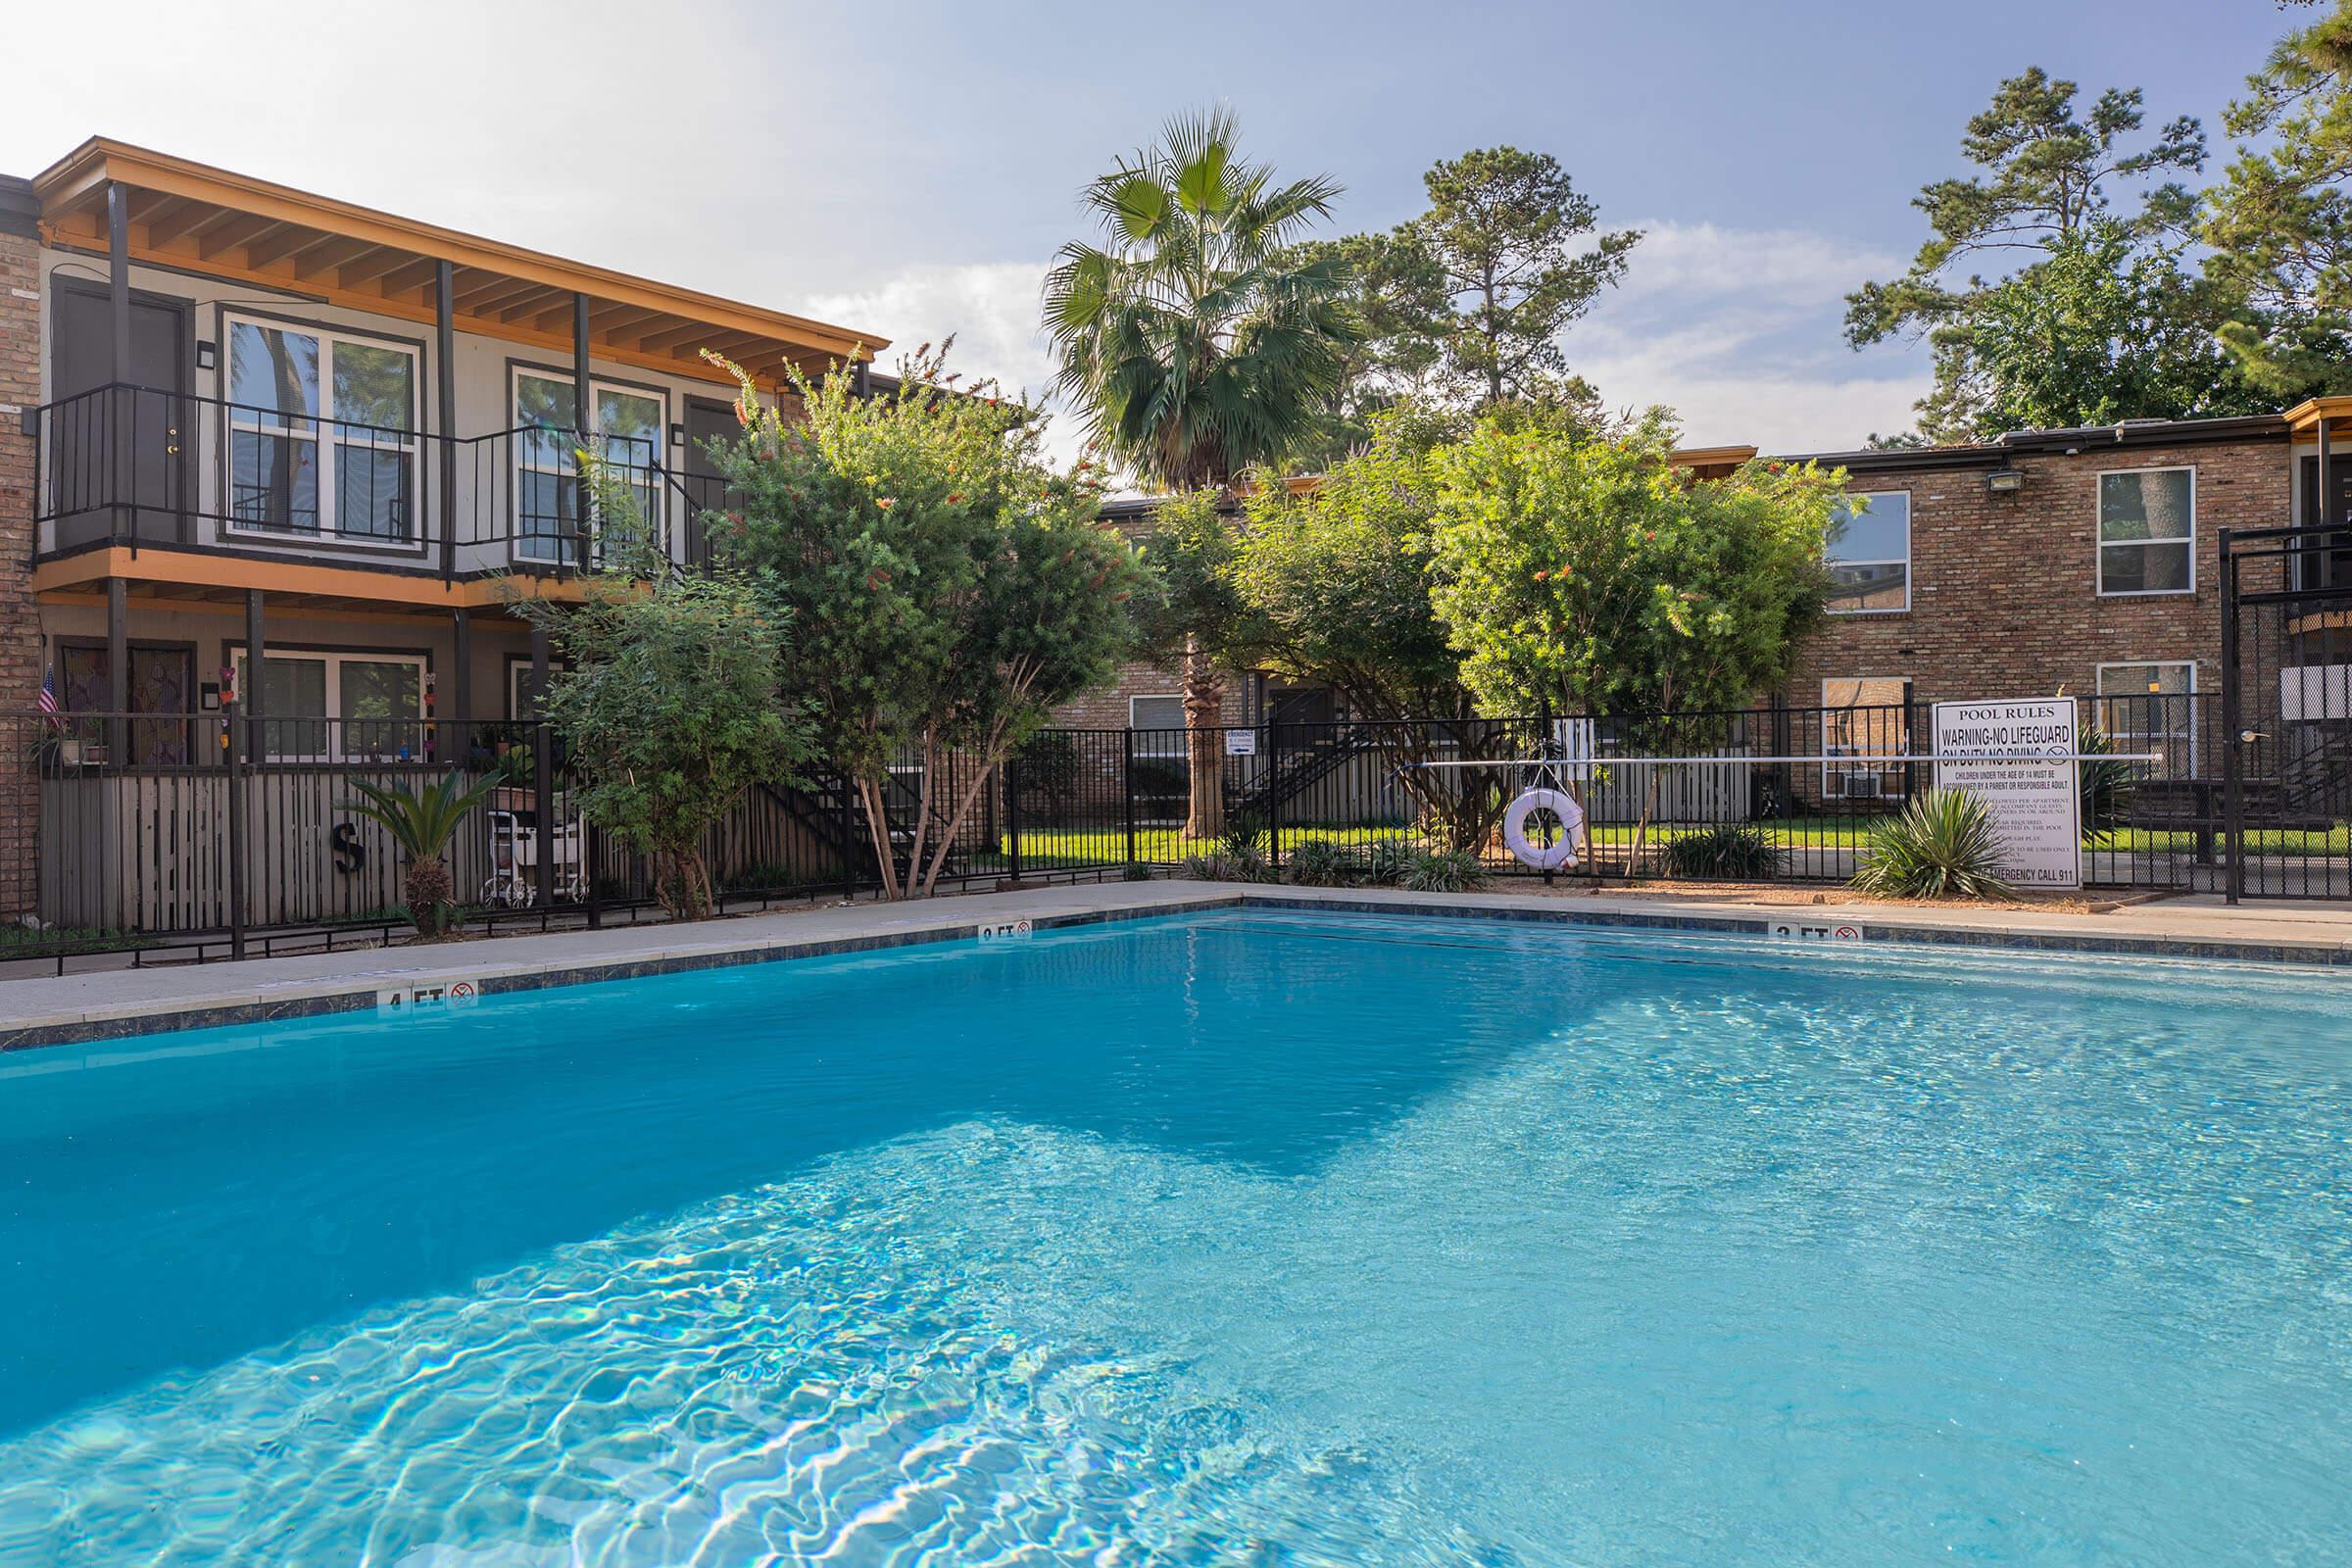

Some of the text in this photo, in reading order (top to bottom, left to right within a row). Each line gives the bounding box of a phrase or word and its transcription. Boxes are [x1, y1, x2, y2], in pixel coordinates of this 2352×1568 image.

[1960, 707, 2055, 721] POOL RULES
[2011, 725, 2070, 745] LIFEGUARD
[1955, 771, 1980, 780] CHILDREN
[1980, 771, 1996, 780] UNDER
[2007, 770, 2018, 779] AGE
[2019, 770, 2026, 779] OF
[2048, 769, 2055, 778] BE
[1989, 781, 2008, 790] PARENT
[2009, 781, 2016, 790] OR
[2017, 781, 2050, 790] RESPONSIBLE
[2037, 868, 2057, 881] CALL
[2058, 869, 2073, 881] 911
